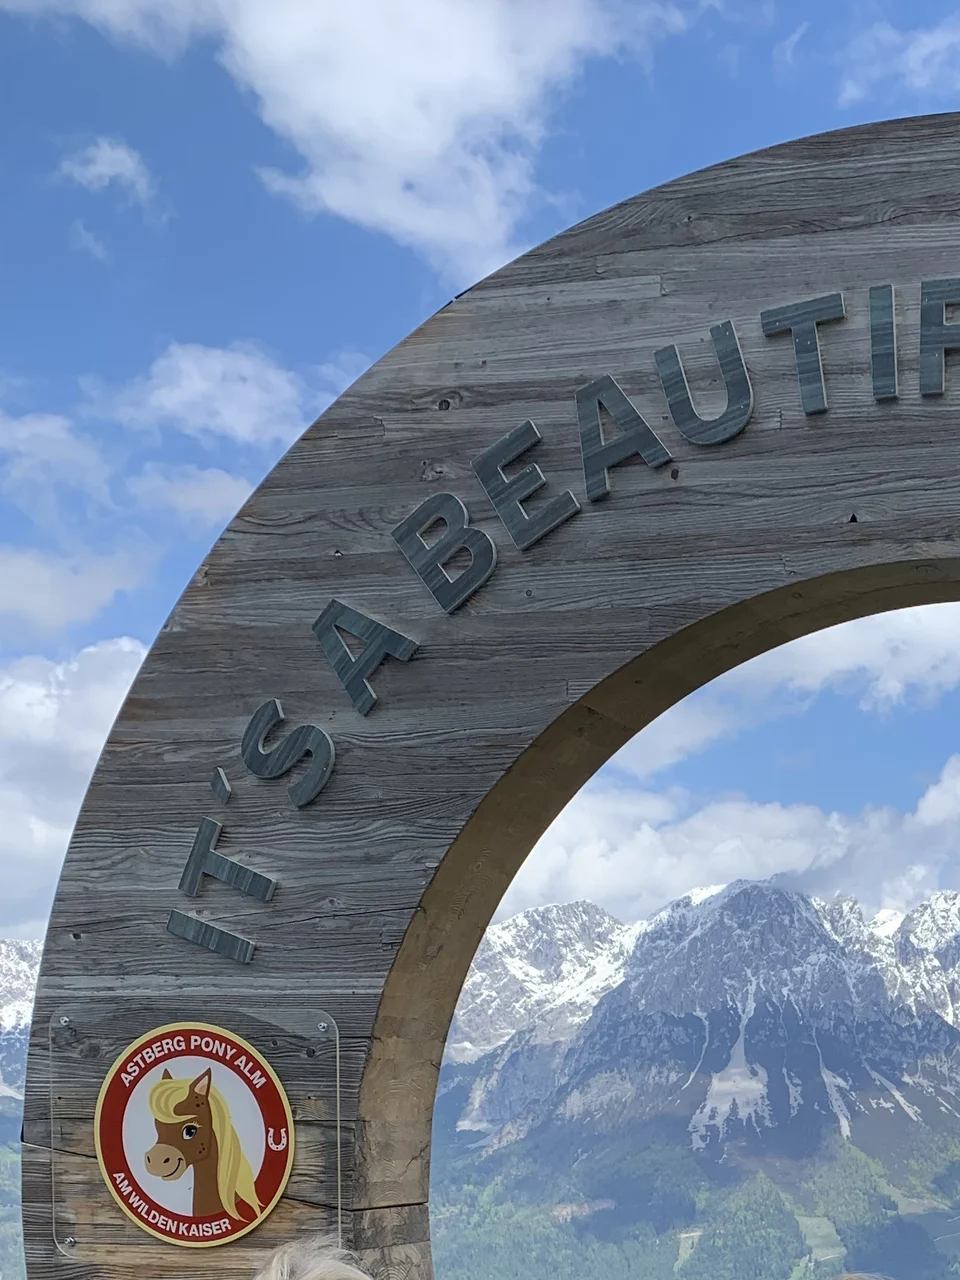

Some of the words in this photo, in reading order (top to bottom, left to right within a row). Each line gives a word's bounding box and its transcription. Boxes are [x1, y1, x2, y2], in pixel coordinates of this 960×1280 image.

[166, 698, 336, 964] IT'S
[311, 598, 420, 717] A
[120, 1036, 186, 1087] ASTBERG
[190, 1035, 237, 1061] PONY
[234, 1055, 267, 1089] ALM
[112, 1172, 134, 1196] AM
[128, 1191, 178, 1234] WILDEN
[178, 1218, 232, 1237] KAISER
